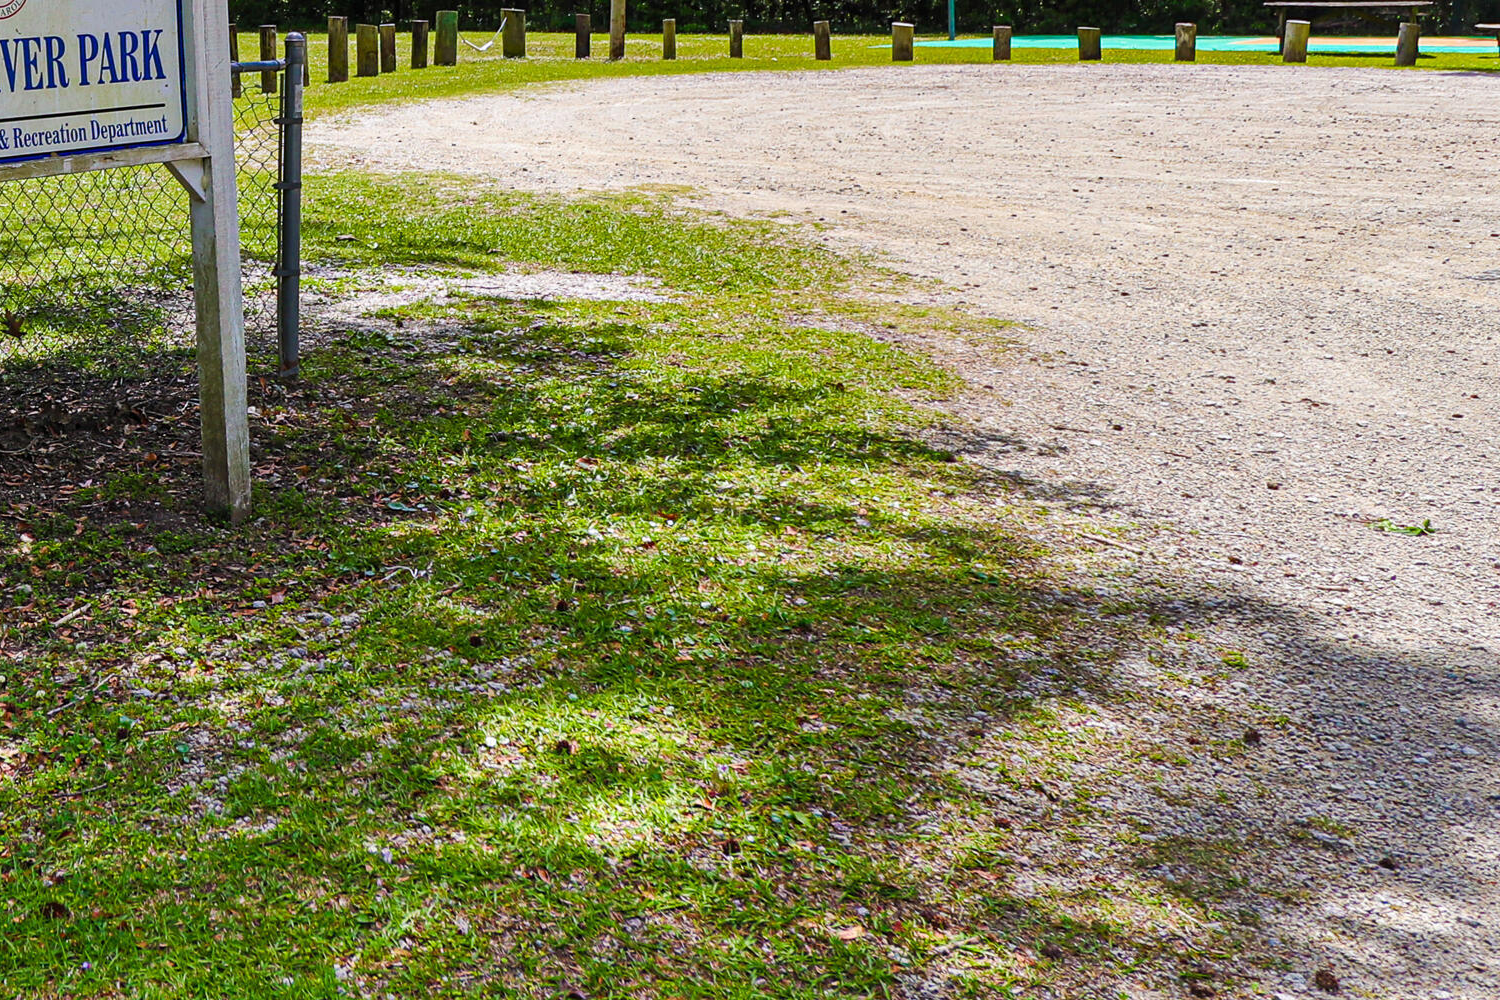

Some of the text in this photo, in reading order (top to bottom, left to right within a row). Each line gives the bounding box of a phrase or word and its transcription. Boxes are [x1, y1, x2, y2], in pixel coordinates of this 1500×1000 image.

[77, 29, 166, 85] PARK
[13, 123, 87, 148] Recreation
[90, 114, 168, 143] Department
